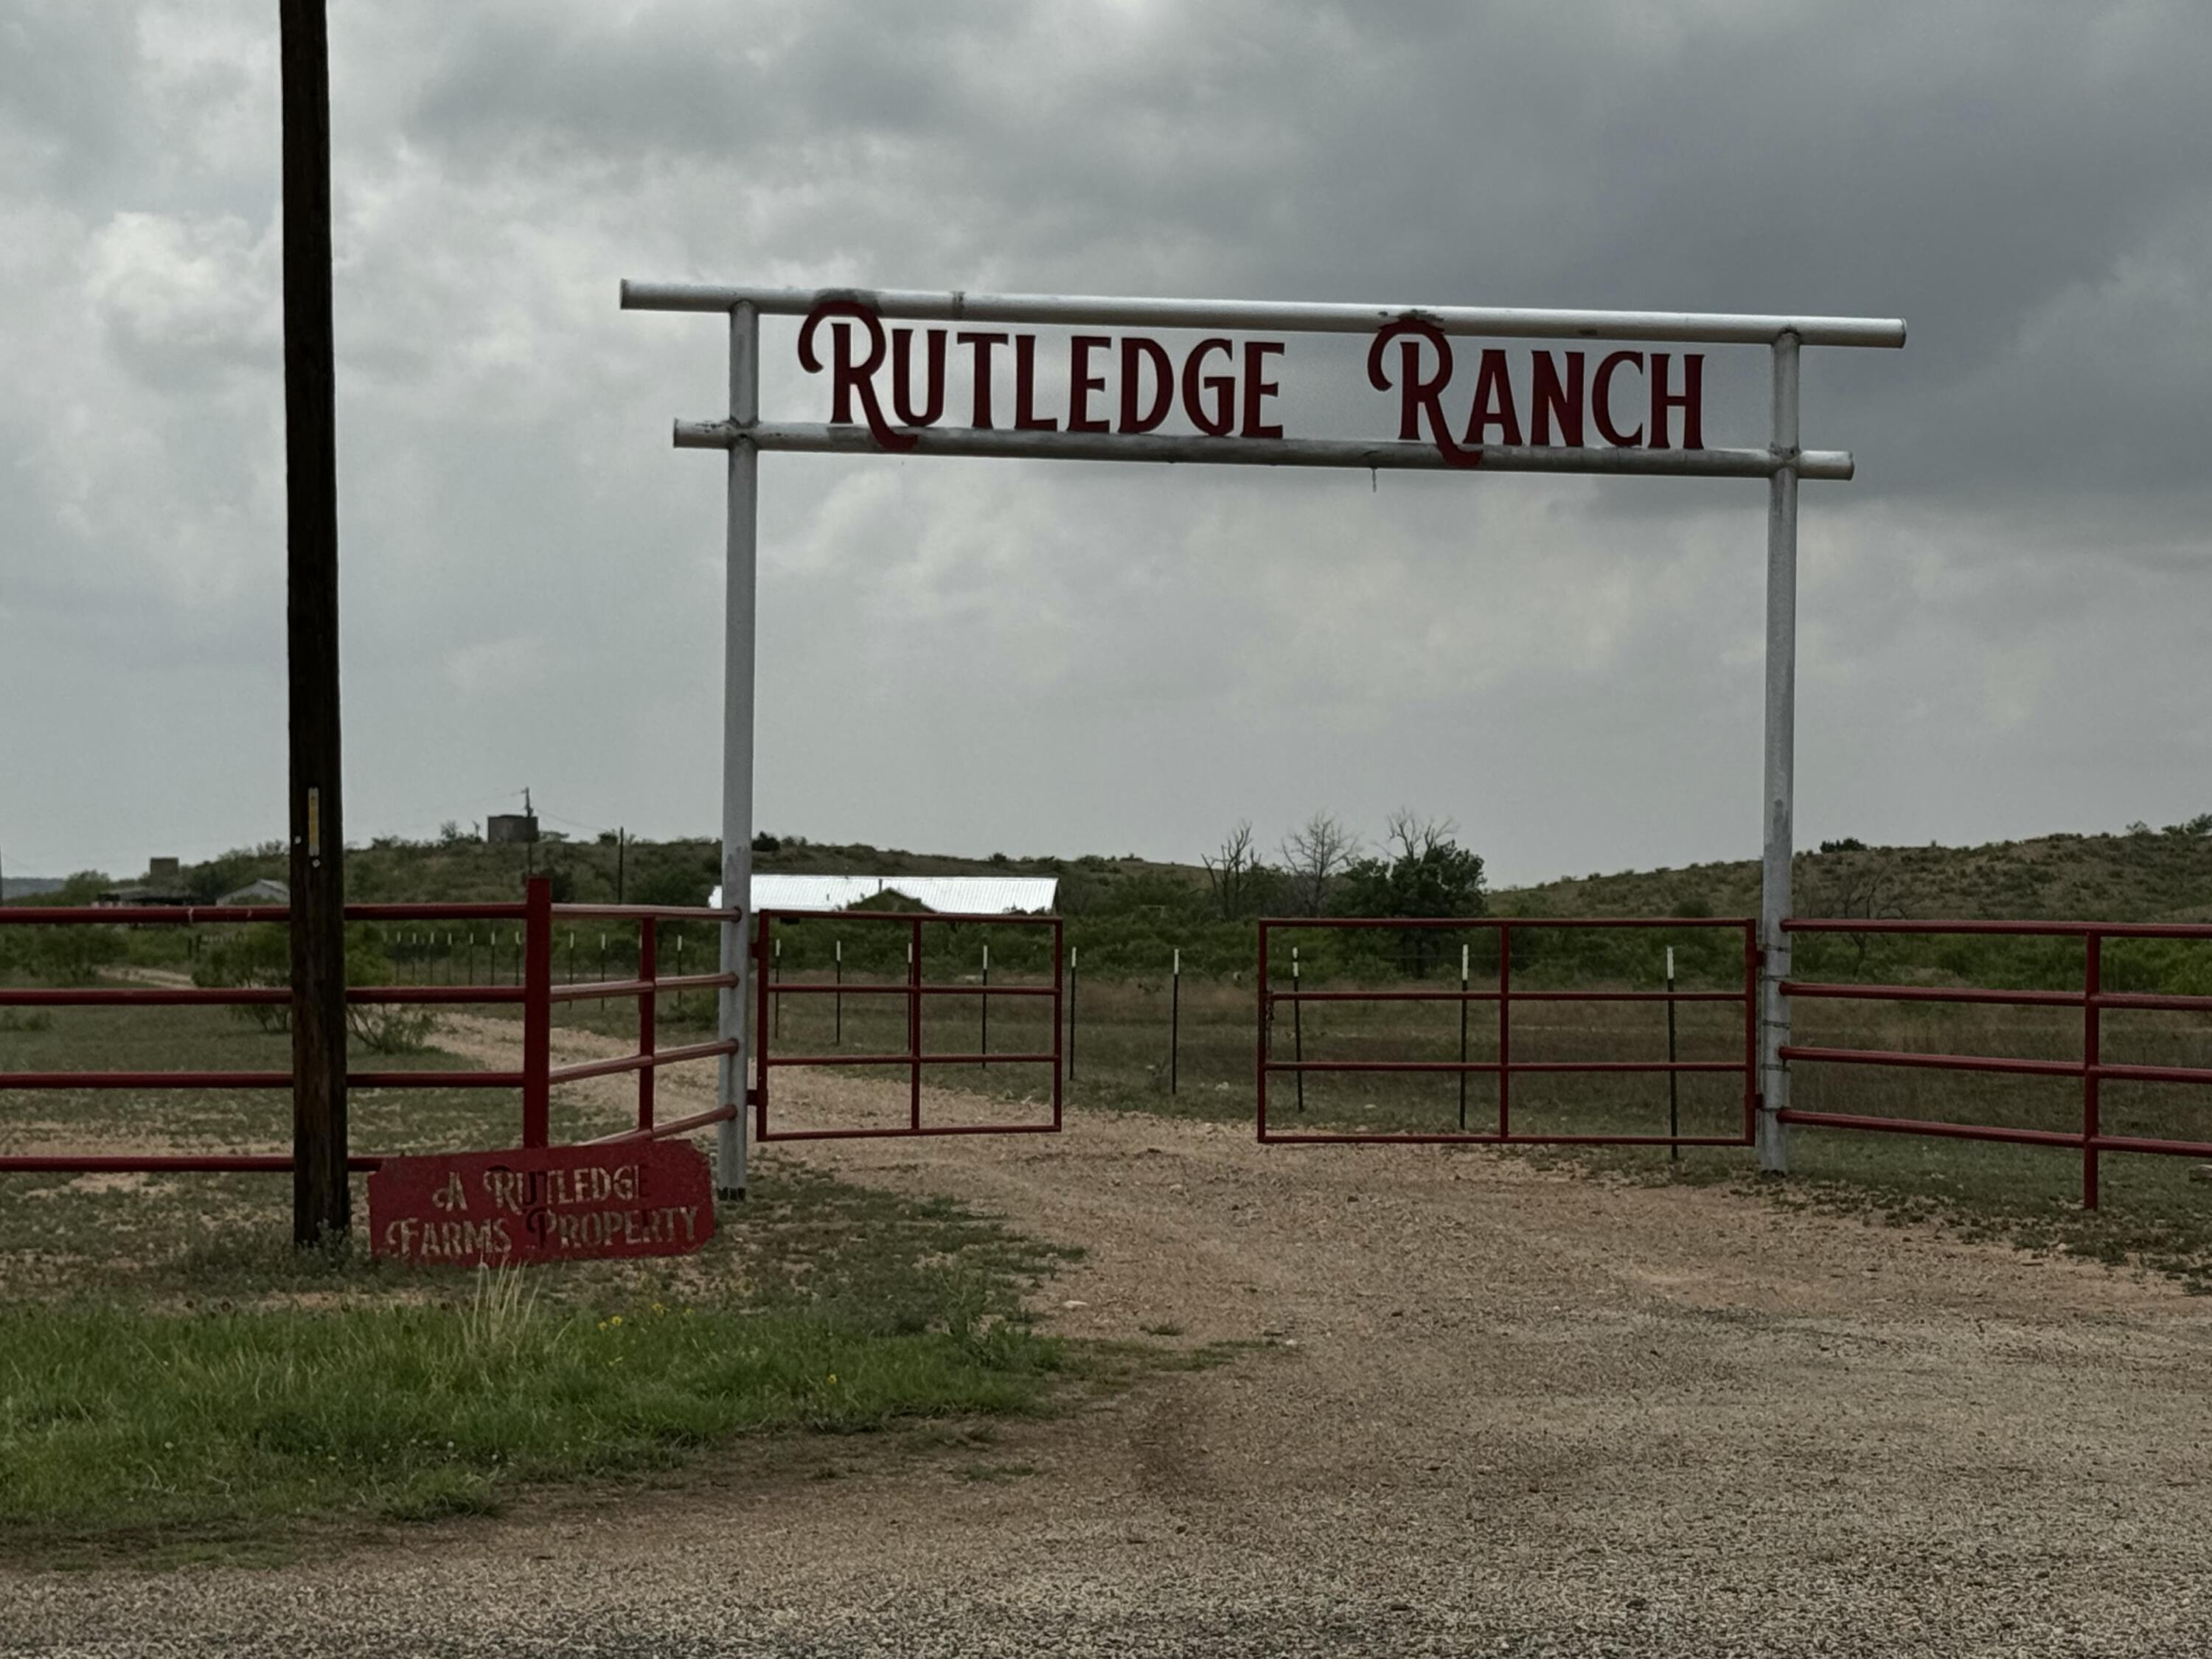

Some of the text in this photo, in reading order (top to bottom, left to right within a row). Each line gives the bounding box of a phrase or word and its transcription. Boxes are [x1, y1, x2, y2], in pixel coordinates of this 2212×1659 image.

[797, 300, 1705, 467] RUTLEDGE RANCH
[432, 1164, 650, 1215] A RUTLEDGE
[386, 1206, 698, 1256] FARMS PROPERTY
